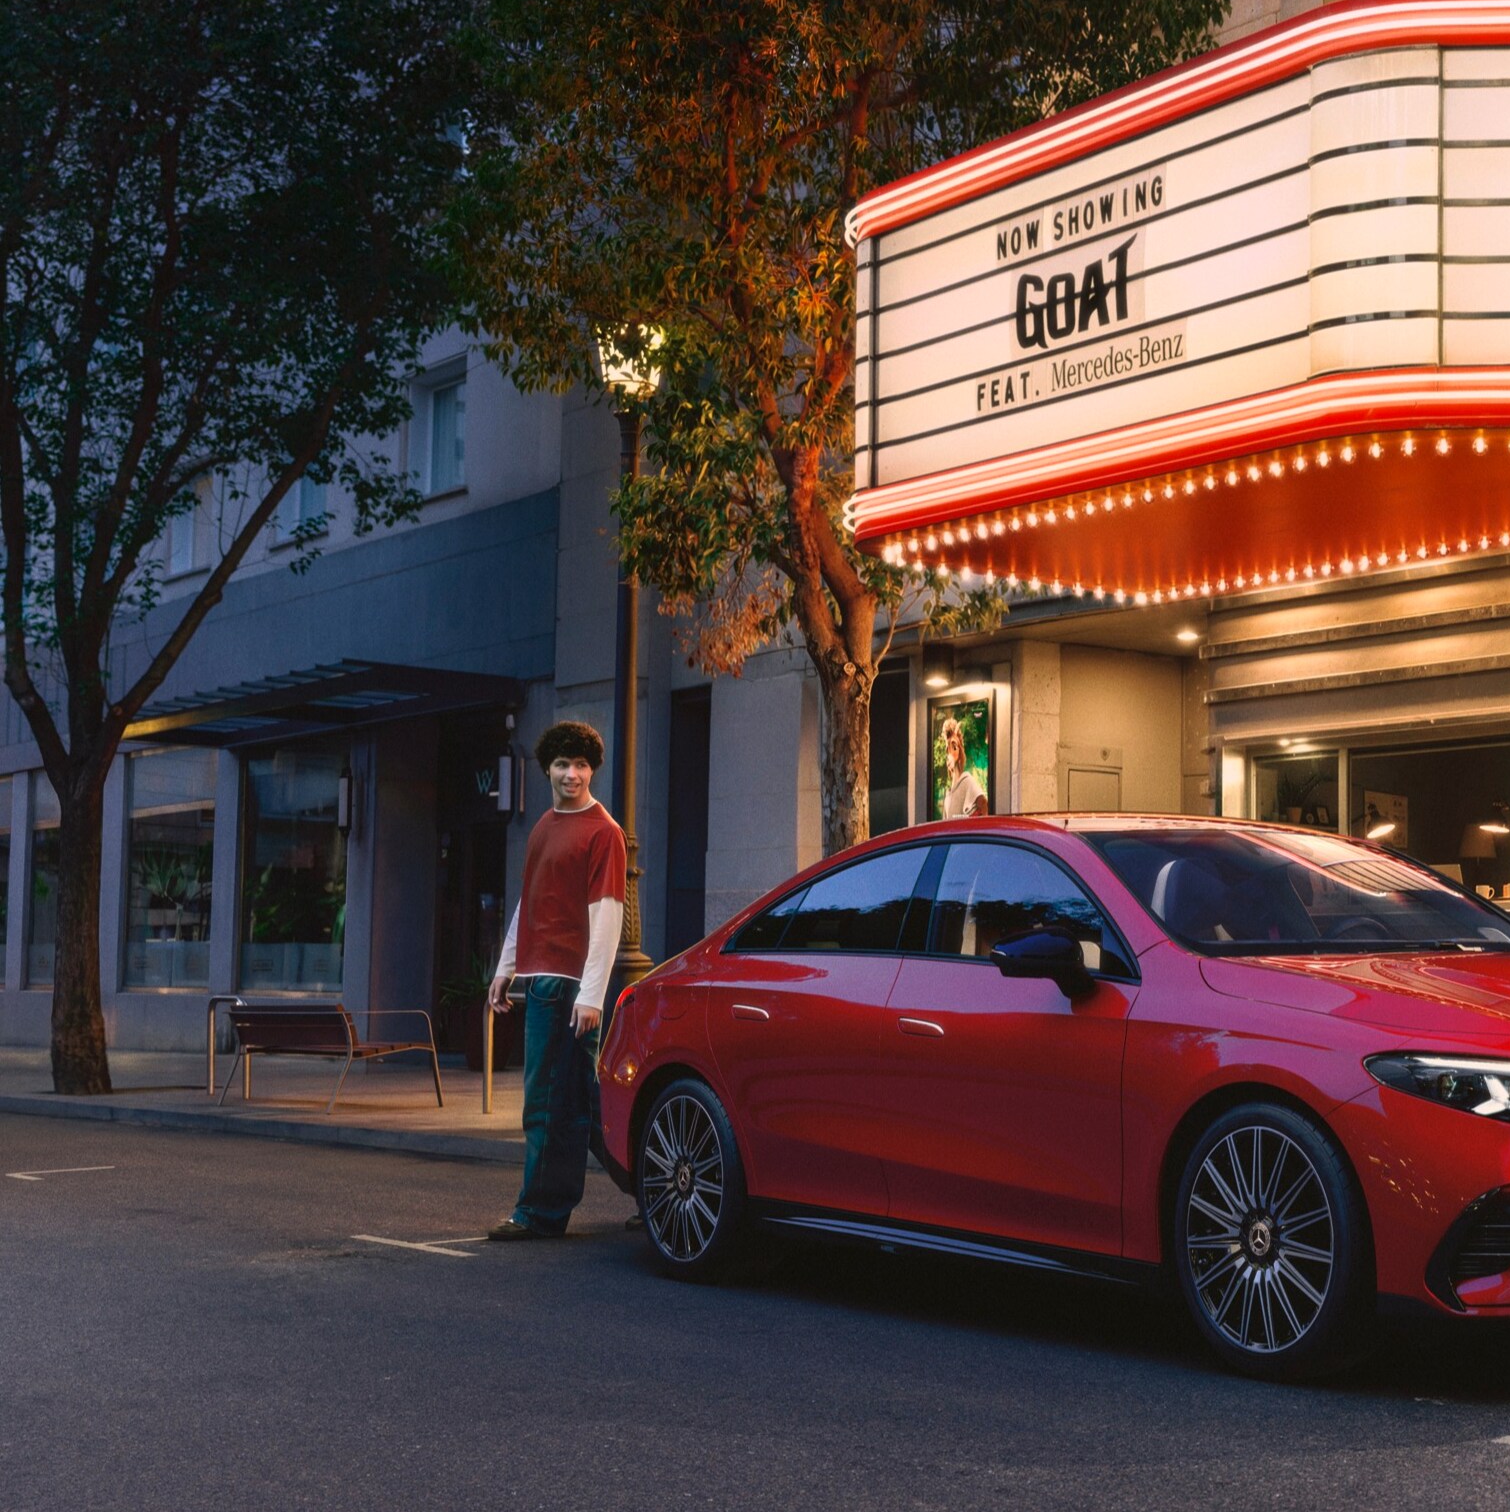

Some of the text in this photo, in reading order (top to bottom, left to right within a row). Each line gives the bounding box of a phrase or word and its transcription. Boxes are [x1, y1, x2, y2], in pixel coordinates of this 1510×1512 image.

[996, 175, 1162, 260] NOW SHOWING
[1016, 233, 1138, 349] GOAT
[977, 334, 1184, 411] FEAT. Mercedes-Benz
